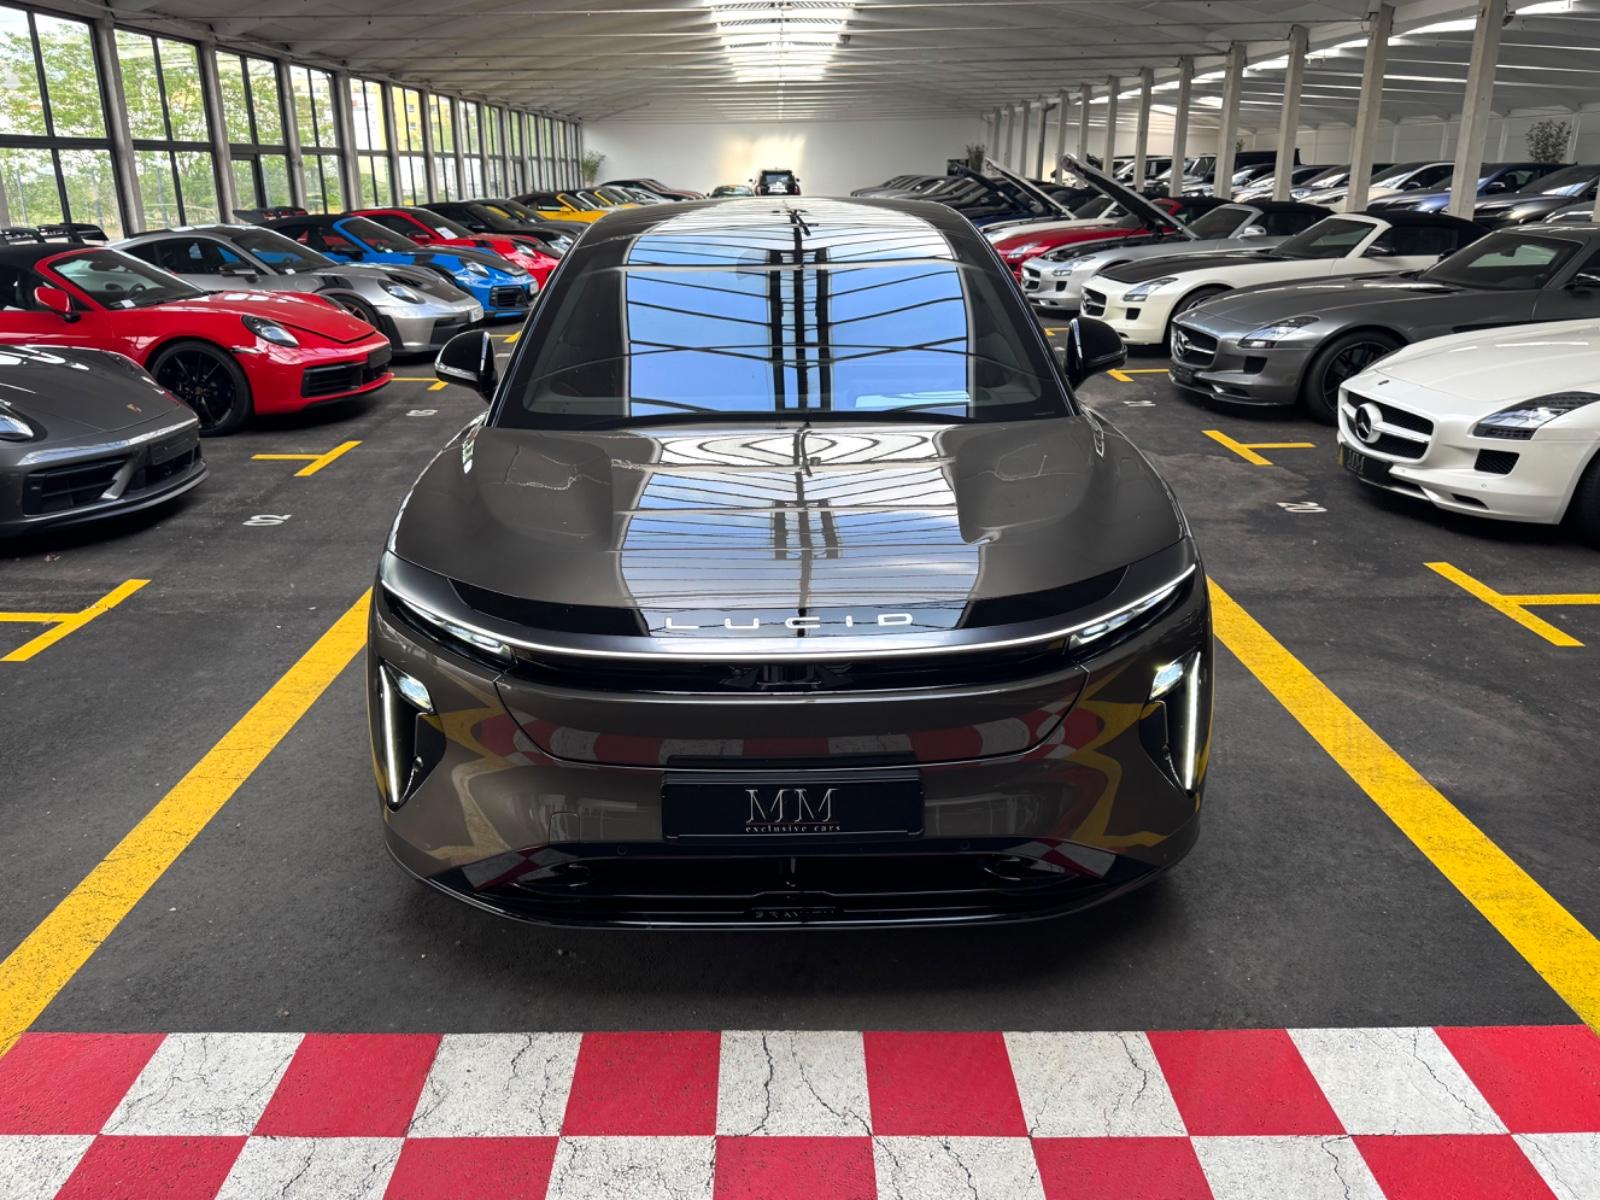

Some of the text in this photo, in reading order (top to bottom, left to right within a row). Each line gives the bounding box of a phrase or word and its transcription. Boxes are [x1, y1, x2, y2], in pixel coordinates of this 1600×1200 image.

[1276, 501, 1328, 513] 20
[665, 613, 913, 629] LUCID
[745, 788, 840, 823] MM
